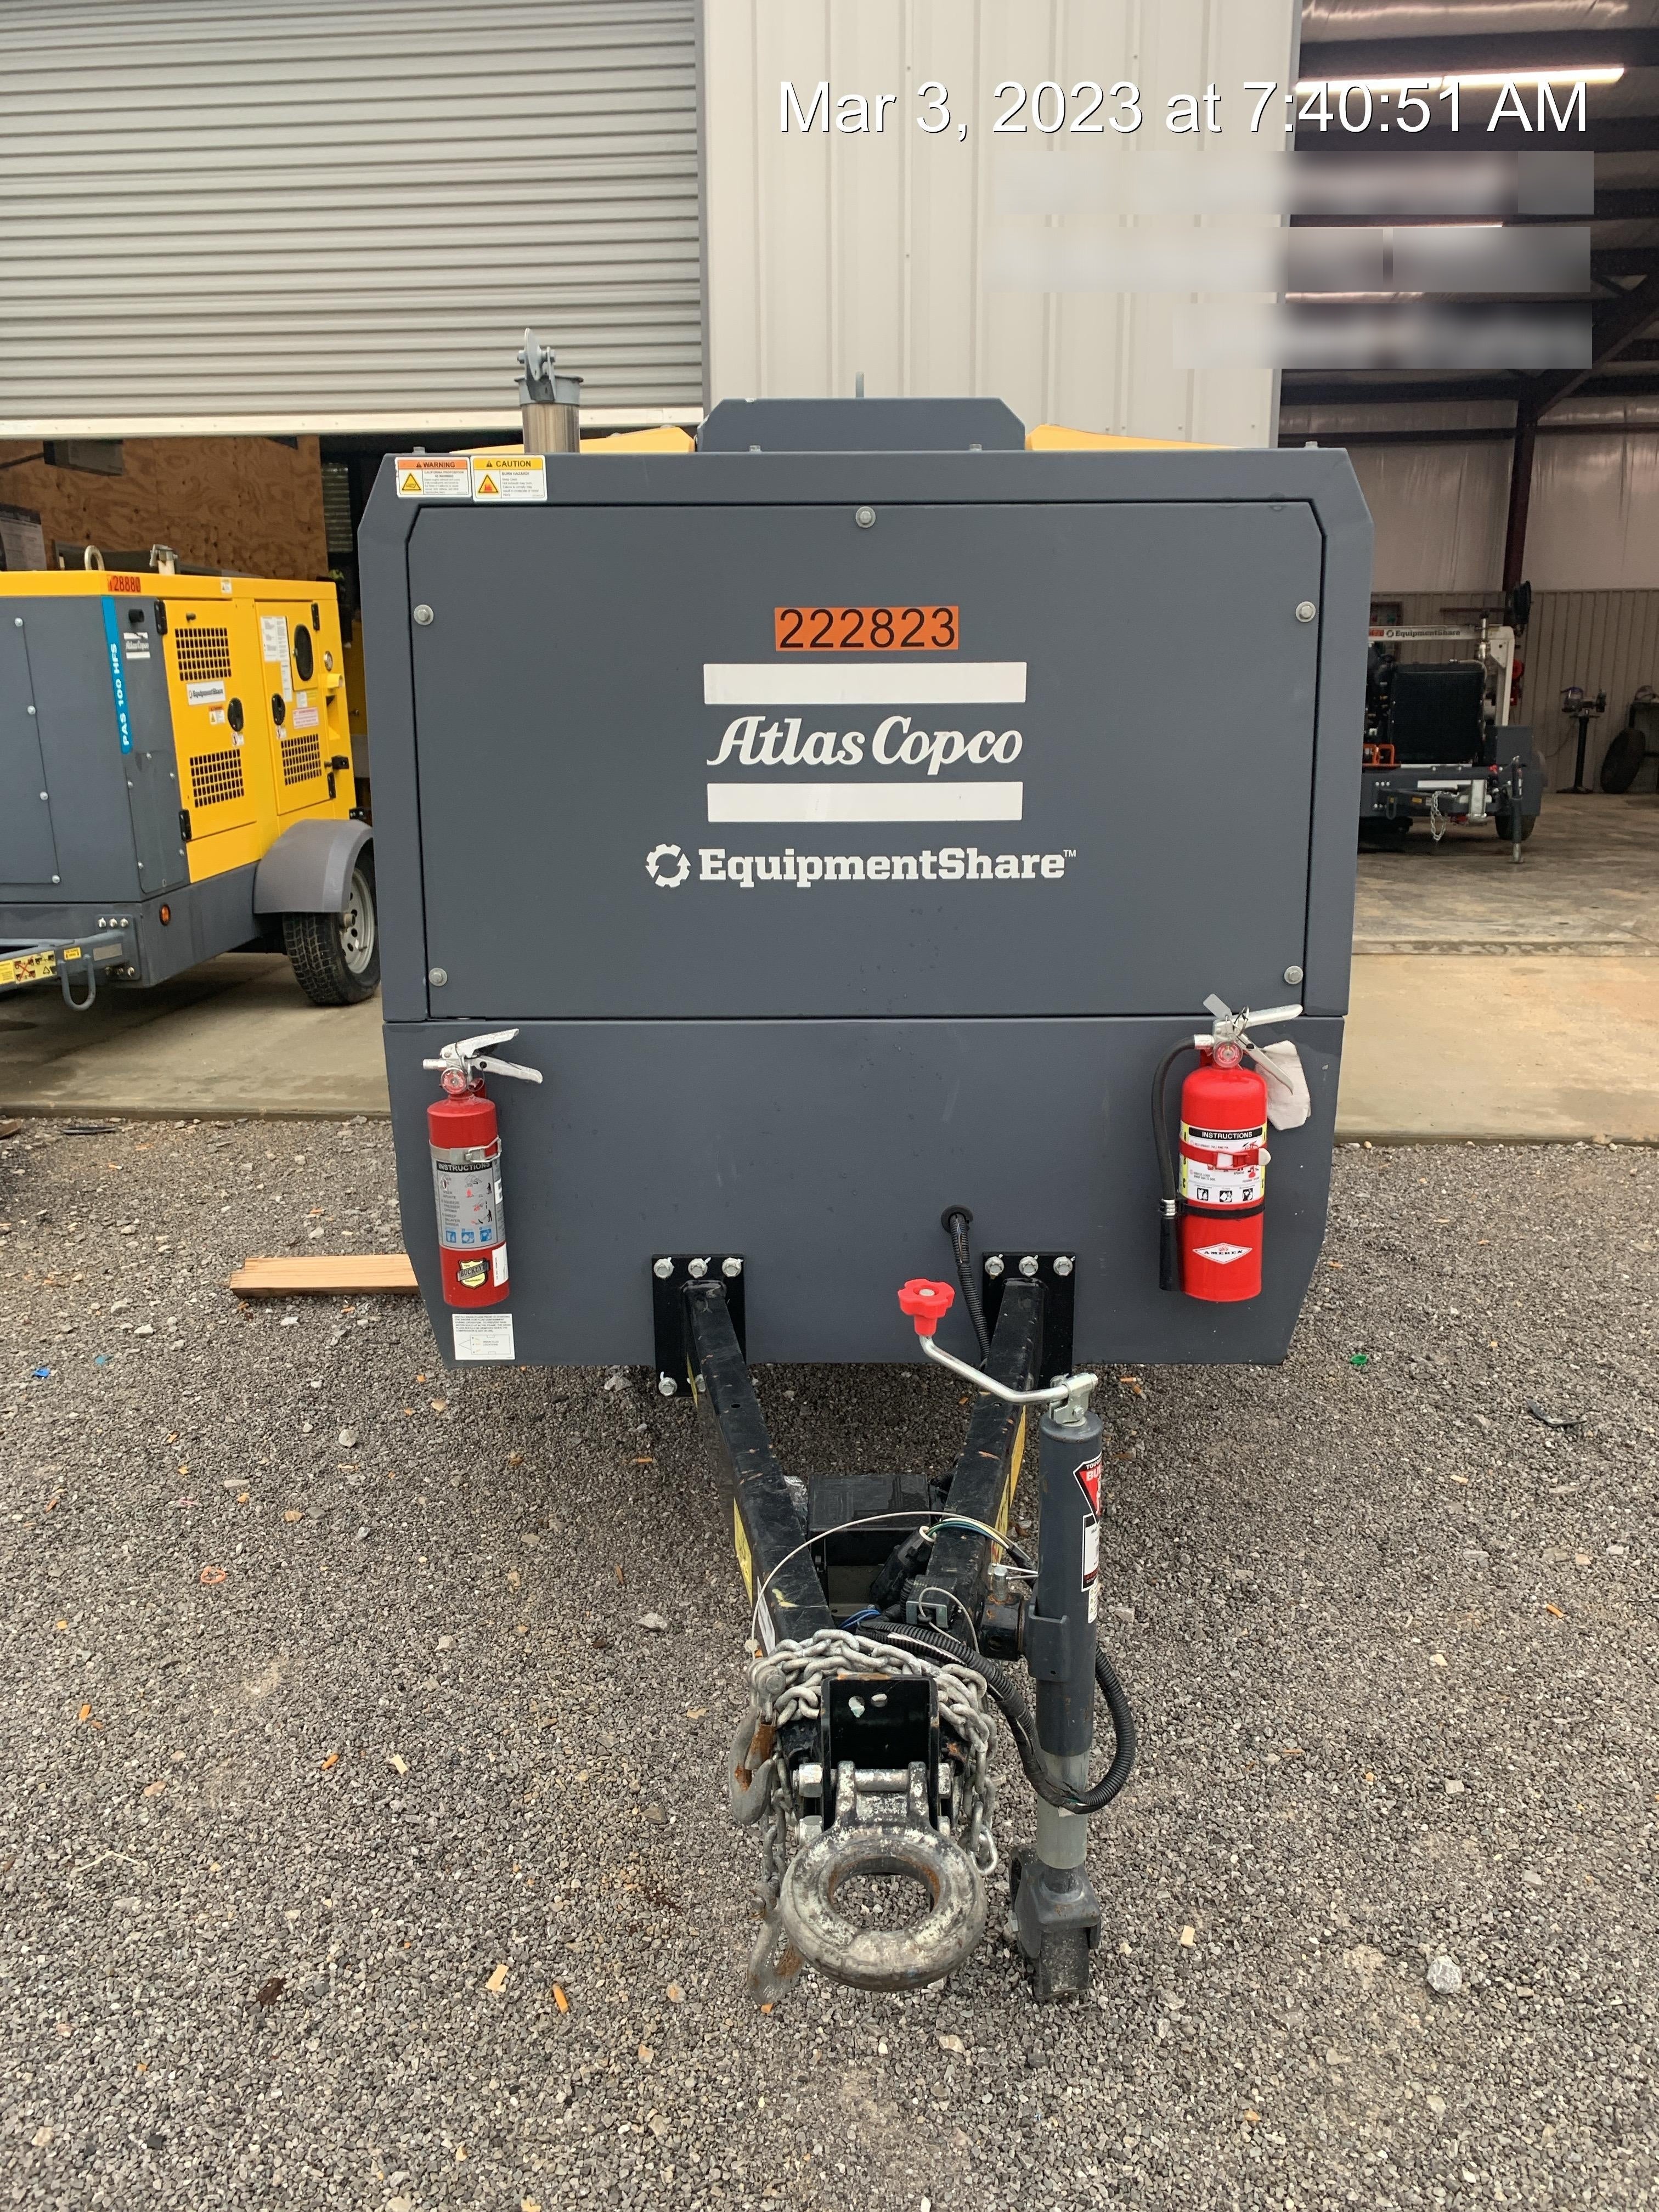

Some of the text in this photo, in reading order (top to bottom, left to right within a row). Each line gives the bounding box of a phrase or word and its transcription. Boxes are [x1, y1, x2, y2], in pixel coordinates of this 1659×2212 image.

[780, 607, 955, 648] 222823
[1395, 629, 1460, 637] EquipmentShare
[110, 643, 129, 746] PAS 100 HFS
[707, 715, 1023, 776] Atlas Copco
[1202, 1131, 1252, 1139] INSTRUCTIONS
[438, 1163, 490, 1171] INSTRUCTIONS
[461, 1262, 488, 1277] BUCKEYE
